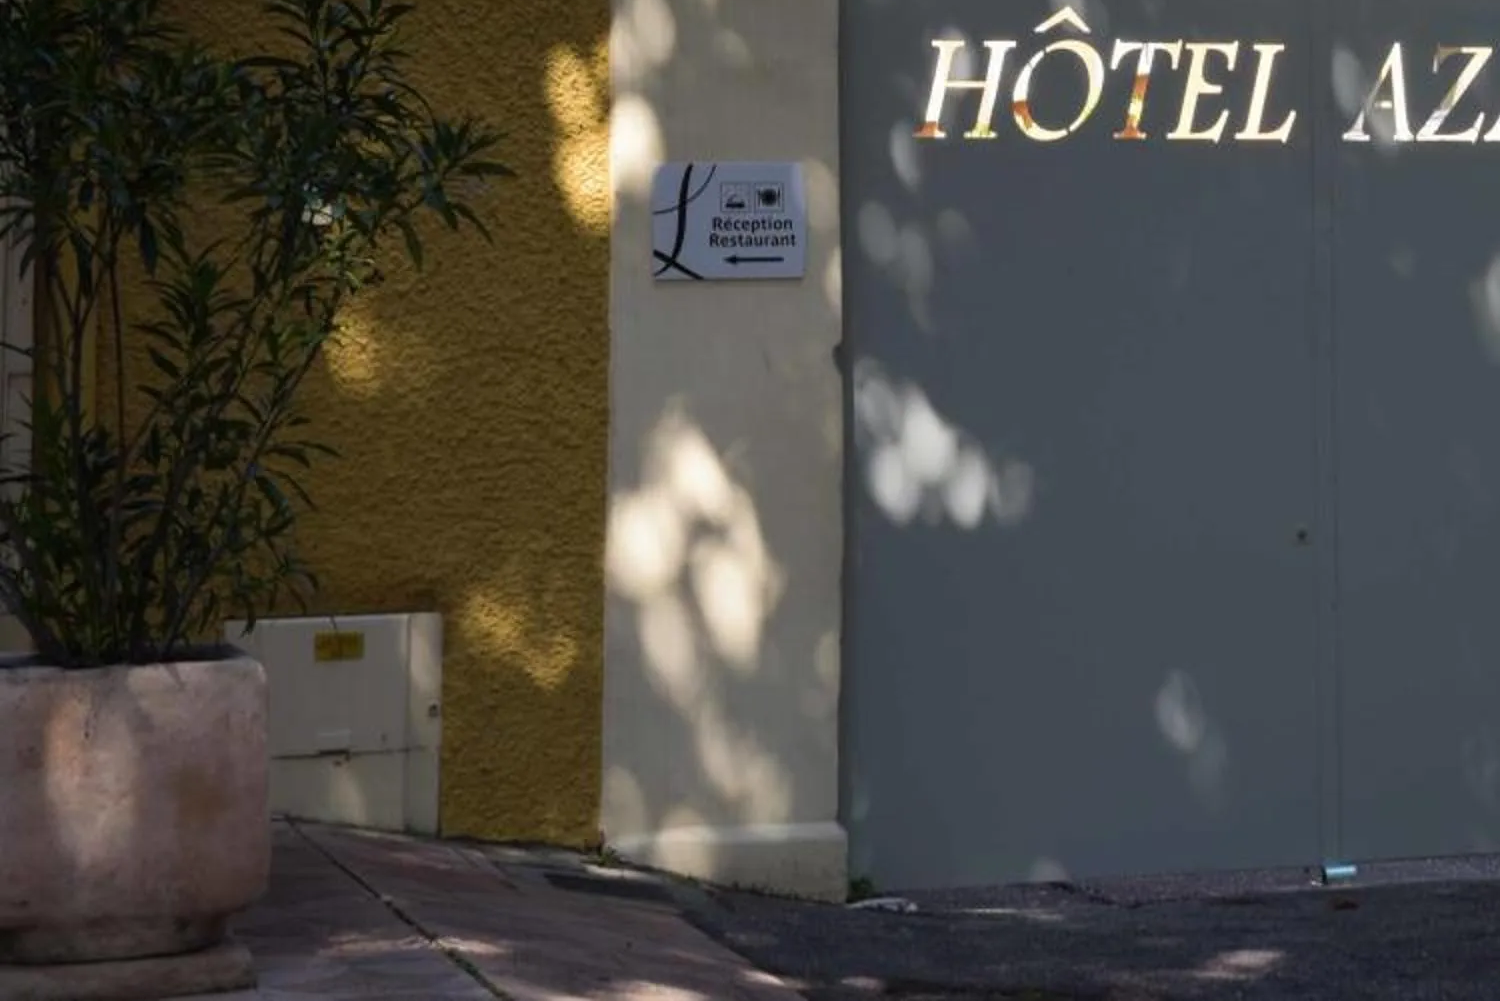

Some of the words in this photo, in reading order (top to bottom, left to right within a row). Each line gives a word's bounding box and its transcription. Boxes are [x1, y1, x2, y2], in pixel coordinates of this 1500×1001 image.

[913, 5, 1298, 144] HÔTEL
[711, 216, 794, 233] Réception
[708, 233, 797, 248] Restaurant
